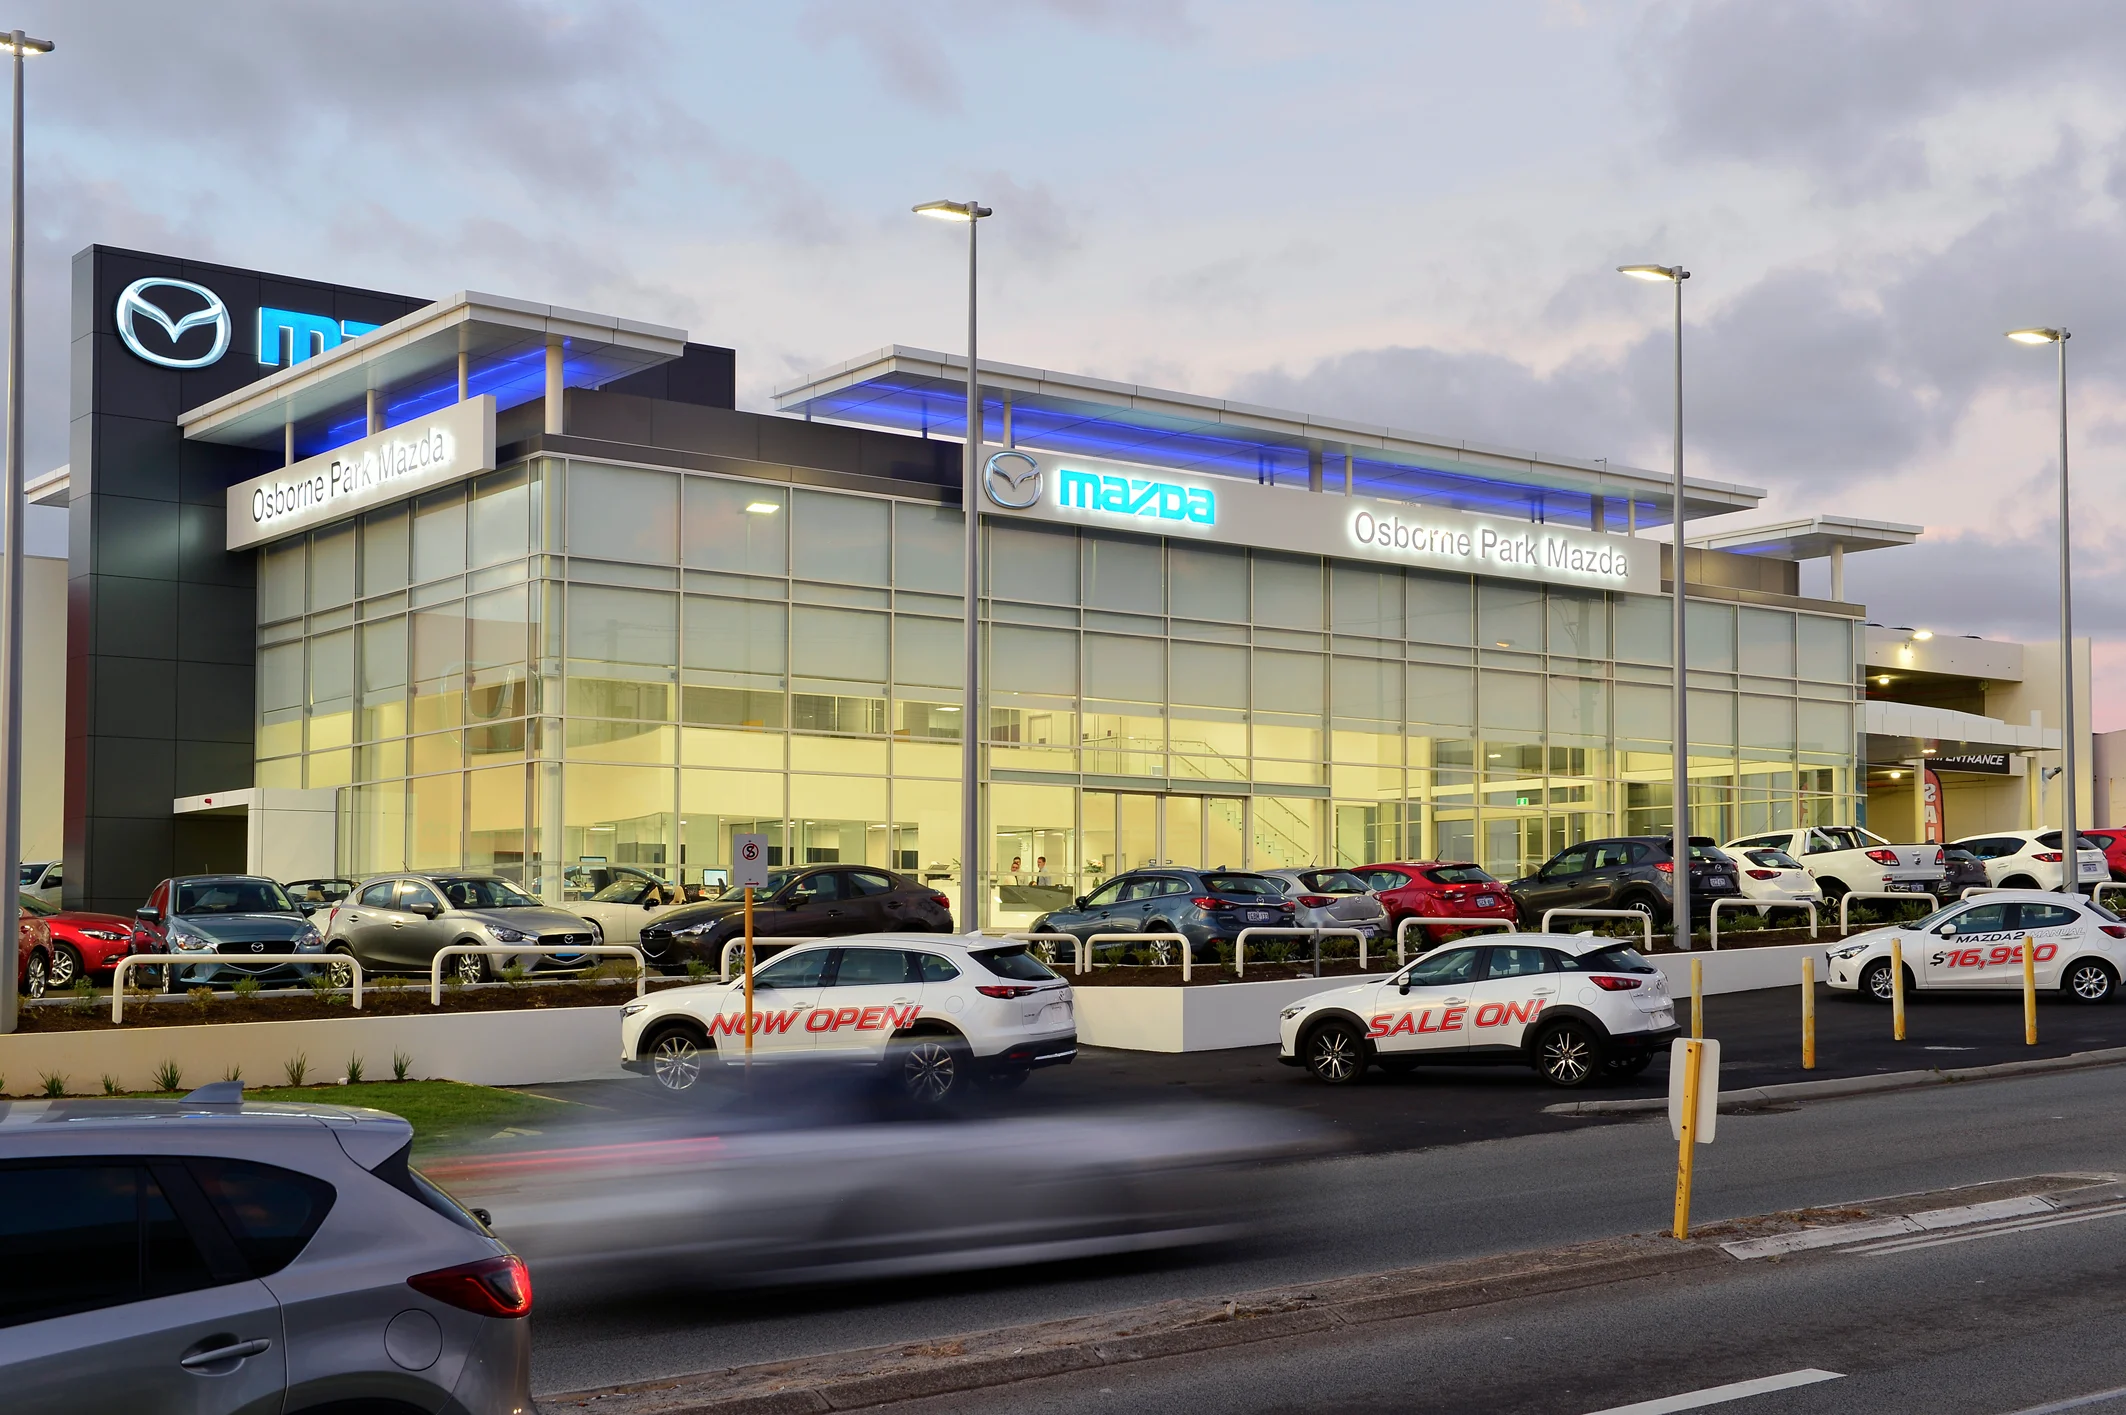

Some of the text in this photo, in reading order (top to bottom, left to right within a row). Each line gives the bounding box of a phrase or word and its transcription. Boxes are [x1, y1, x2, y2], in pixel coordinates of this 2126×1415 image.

[252, 427, 445, 523] Osborne Park Mazda
[1059, 468, 1215, 526] mazda
[1354, 511, 1629, 578] Osborne Park Mazda
[1956, 926, 2087, 944] MAZDA2 MANUAL
[707, 1004, 924, 1037] NOW OPEN!
[1365, 997, 1547, 1040] SALE ON!
